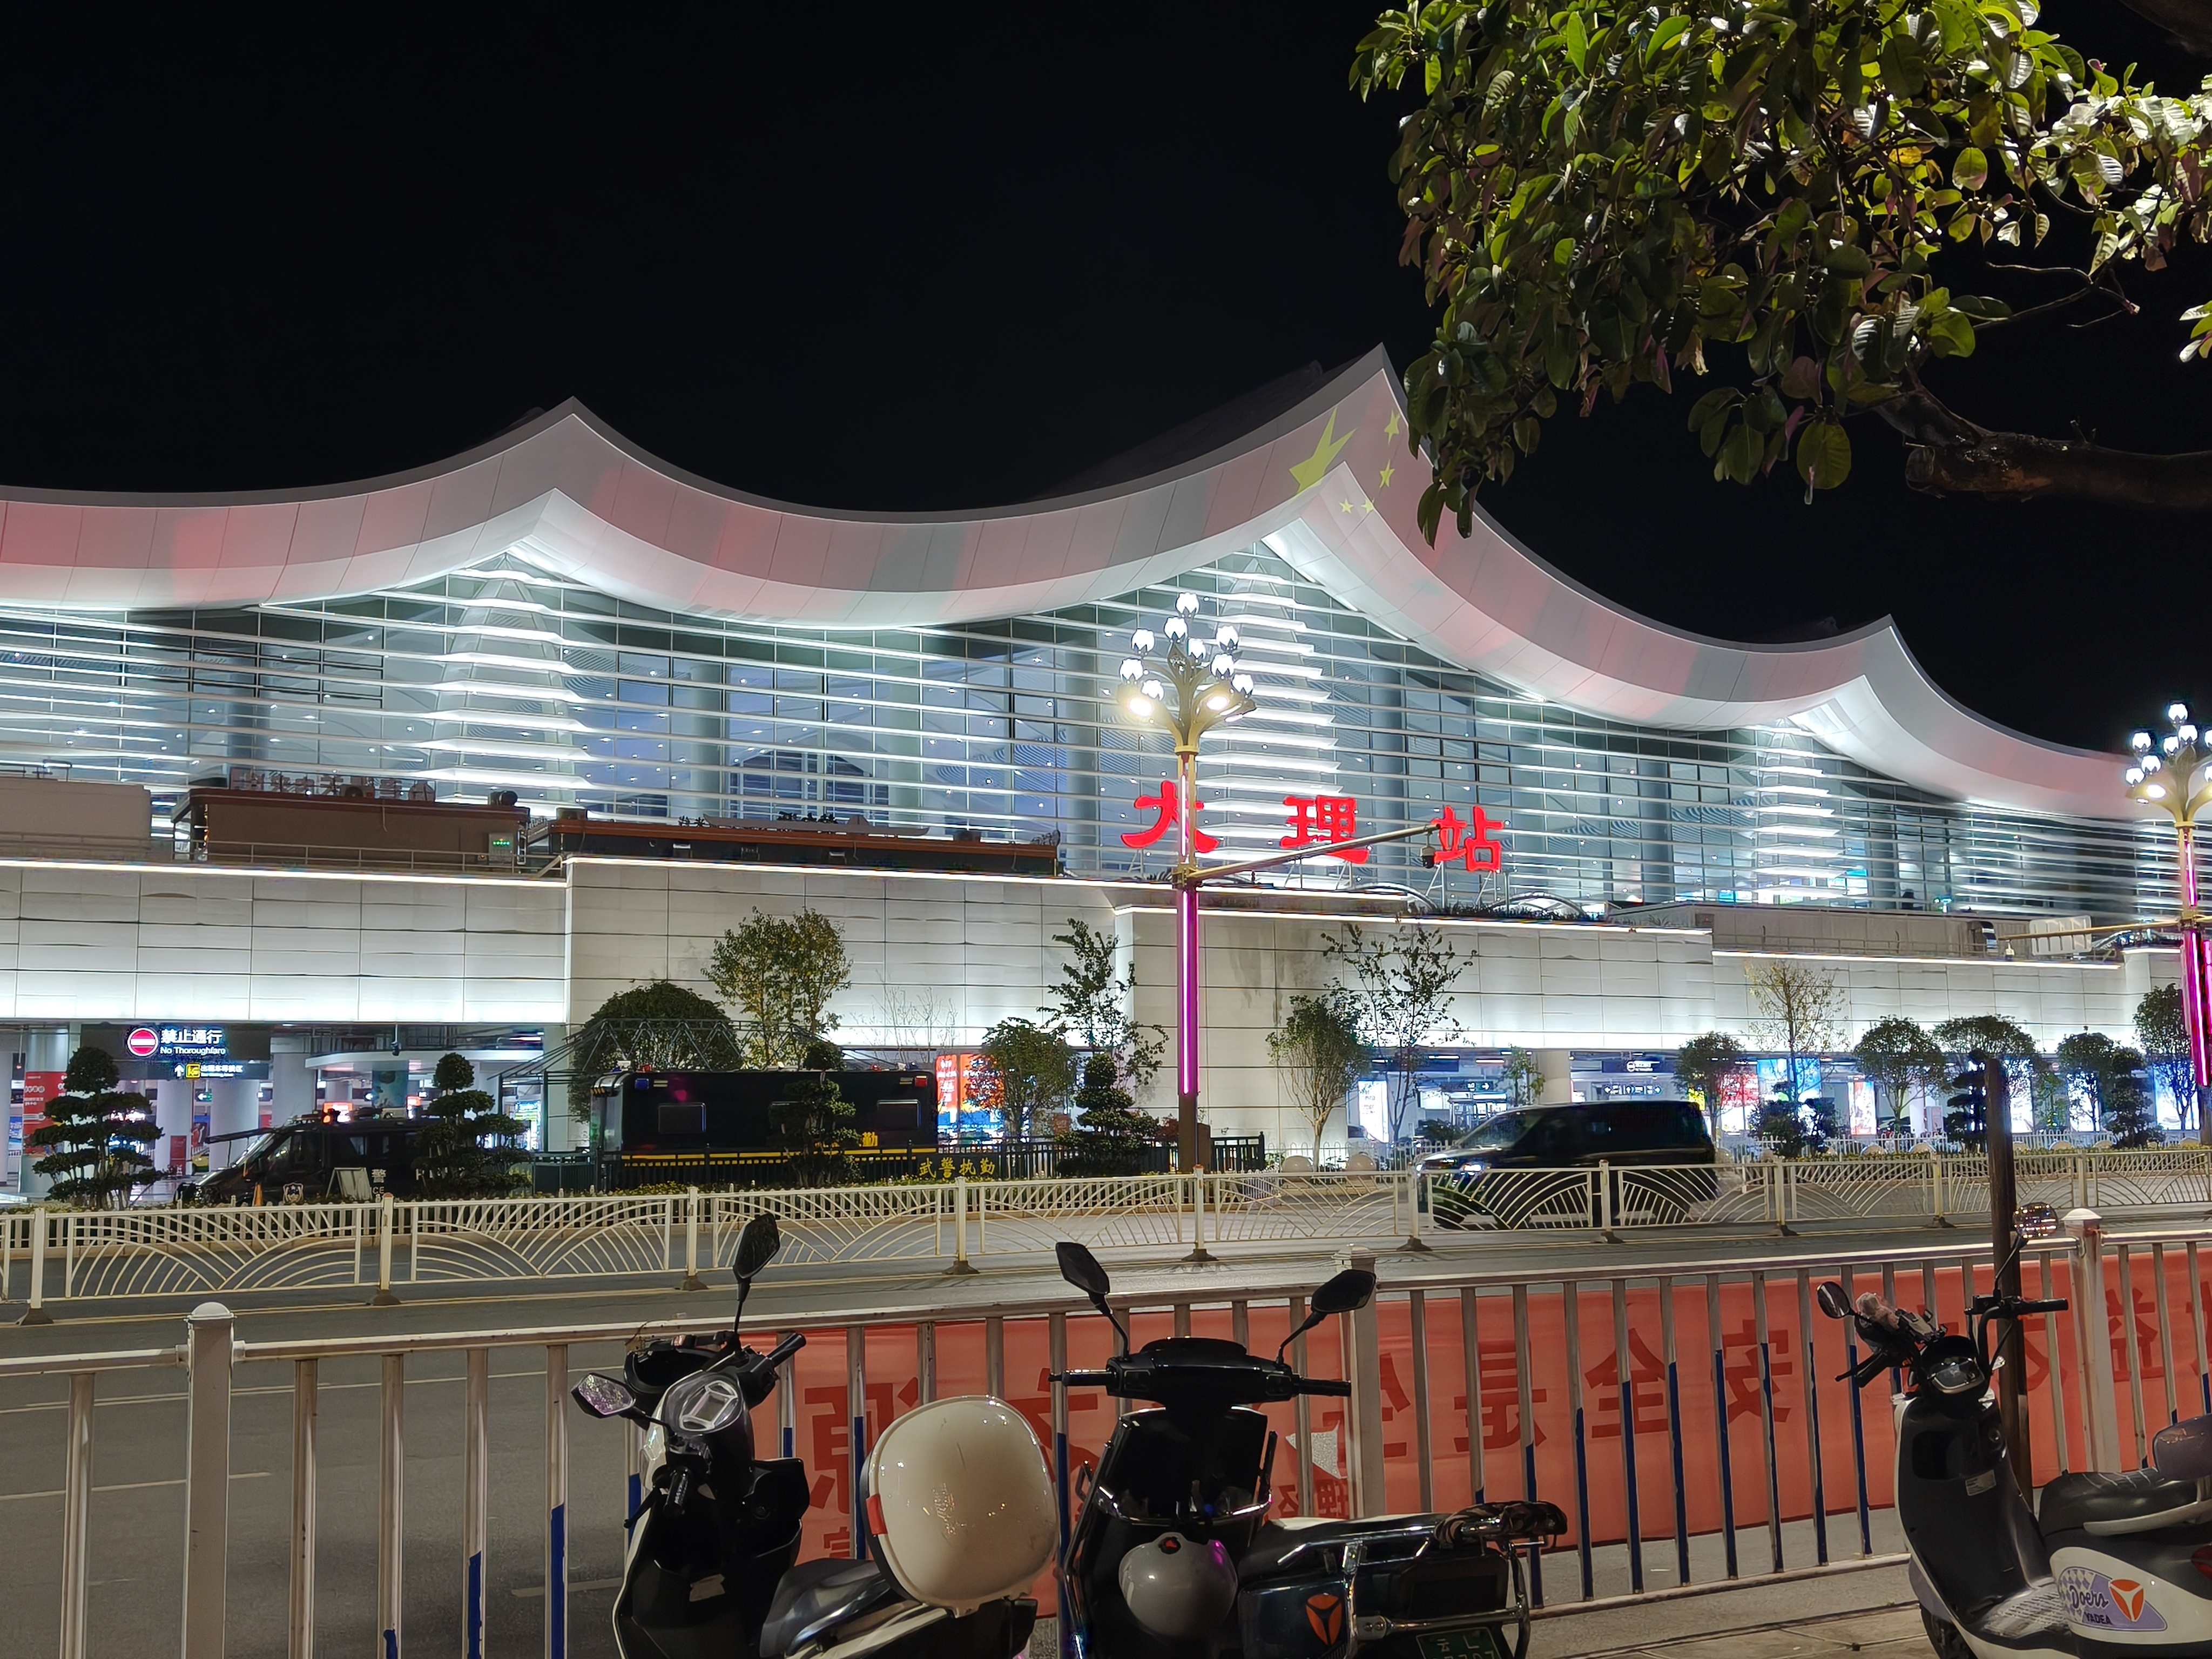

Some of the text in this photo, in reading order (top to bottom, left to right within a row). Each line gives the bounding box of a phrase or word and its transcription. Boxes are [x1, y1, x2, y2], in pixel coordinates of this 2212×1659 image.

[1120, 780, 1505, 873] 大理站
[160, 1029, 222, 1044] 禁止通行
[919, 1157, 996, 1179] 武警执勤
[2069, 1585, 2109, 1609] Doers
[2084, 1611, 2113, 1626] YADEA
